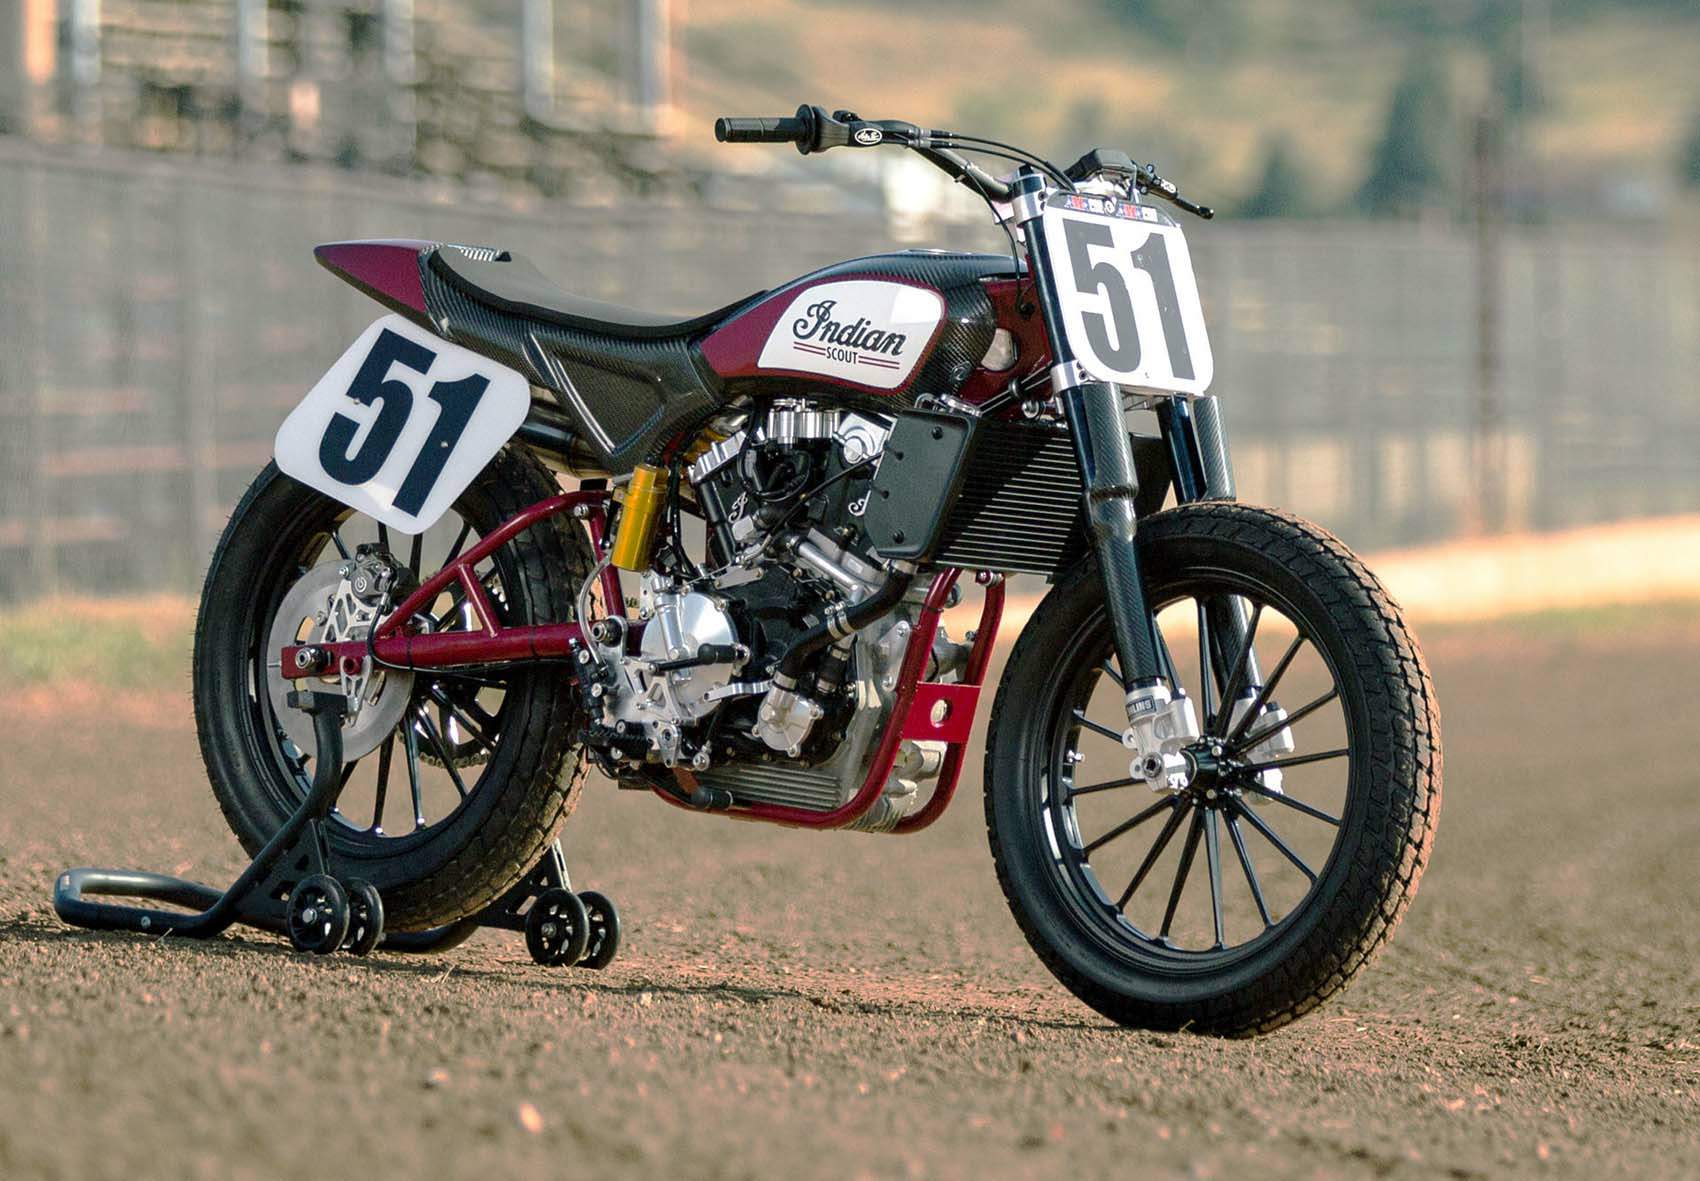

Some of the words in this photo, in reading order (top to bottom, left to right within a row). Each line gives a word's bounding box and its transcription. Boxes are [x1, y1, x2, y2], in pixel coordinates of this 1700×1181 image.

[793, 300, 907, 356] Indian
[1063, 218, 1195, 380] 51
[826, 346, 859, 364] SCOUT
[319, 328, 491, 517] 51
